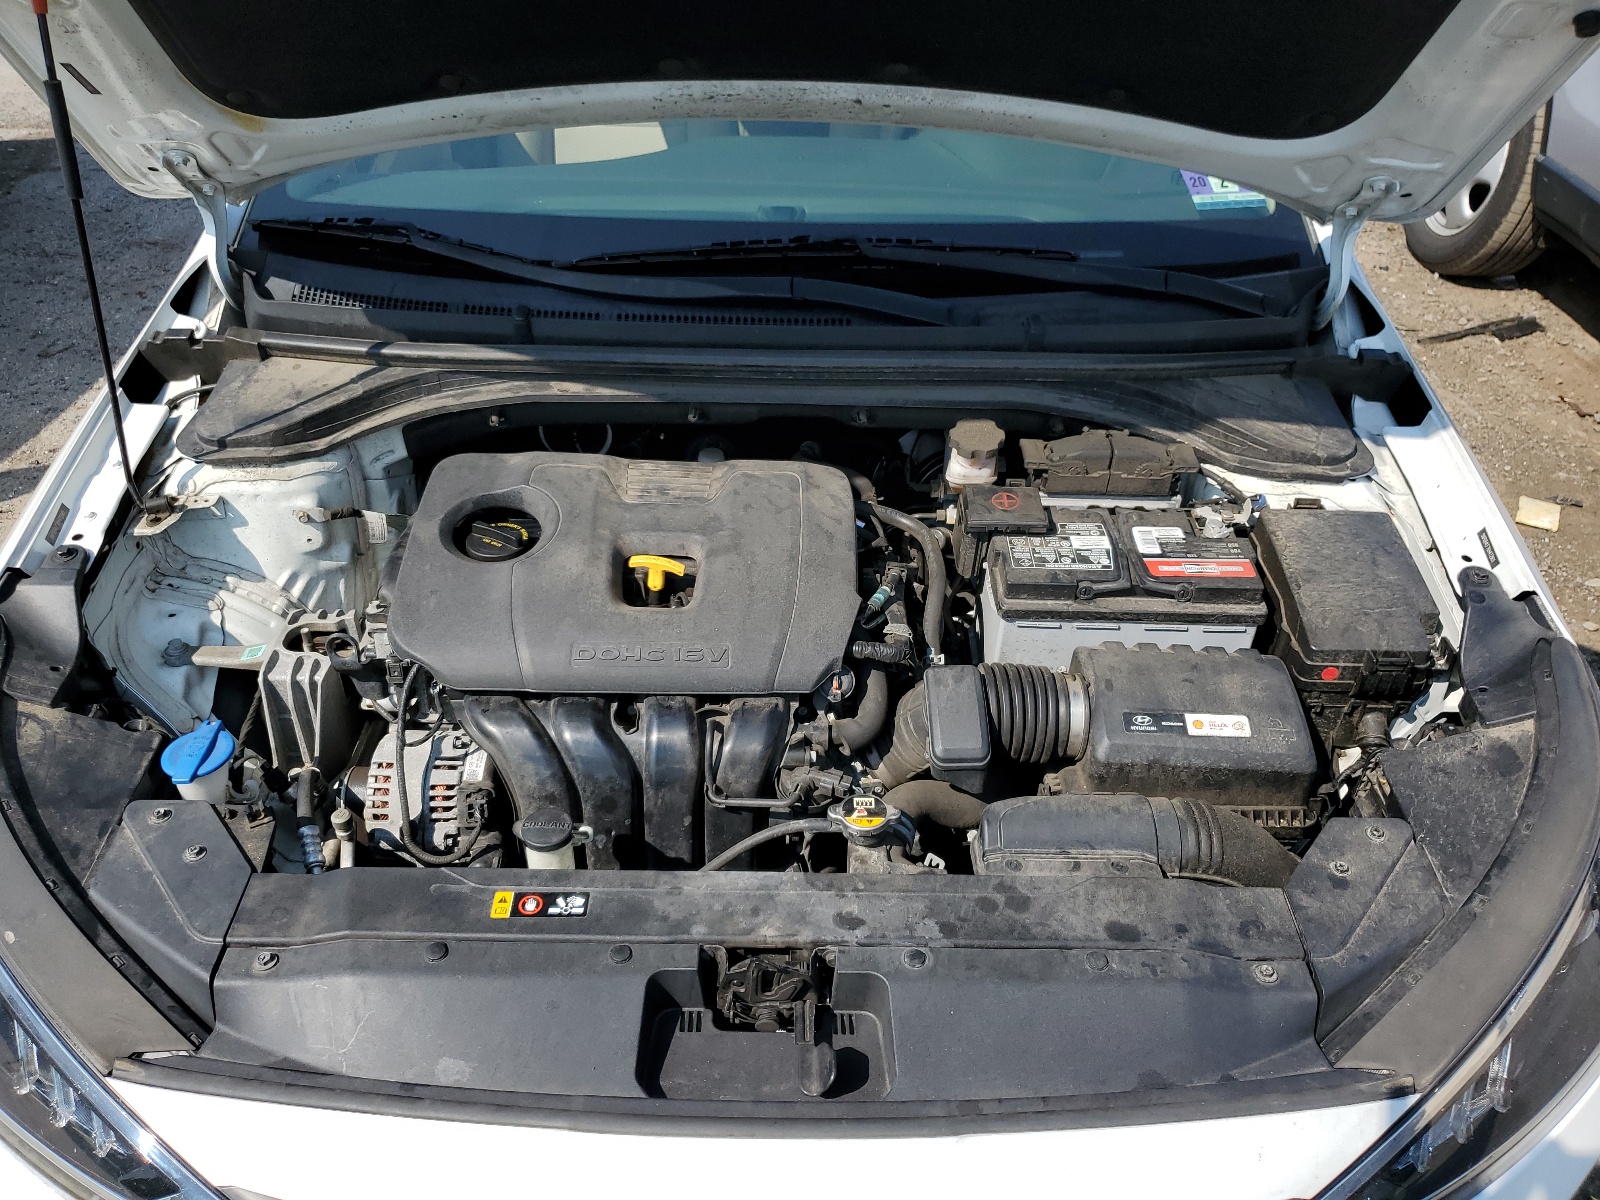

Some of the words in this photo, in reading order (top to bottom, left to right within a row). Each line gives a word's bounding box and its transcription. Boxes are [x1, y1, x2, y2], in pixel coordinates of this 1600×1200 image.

[1189, 176, 1207, 188] 20
[573, 646, 666, 662] DOHC
[674, 647, 728, 663] 16V
[522, 821, 572, 830] COOLANT
